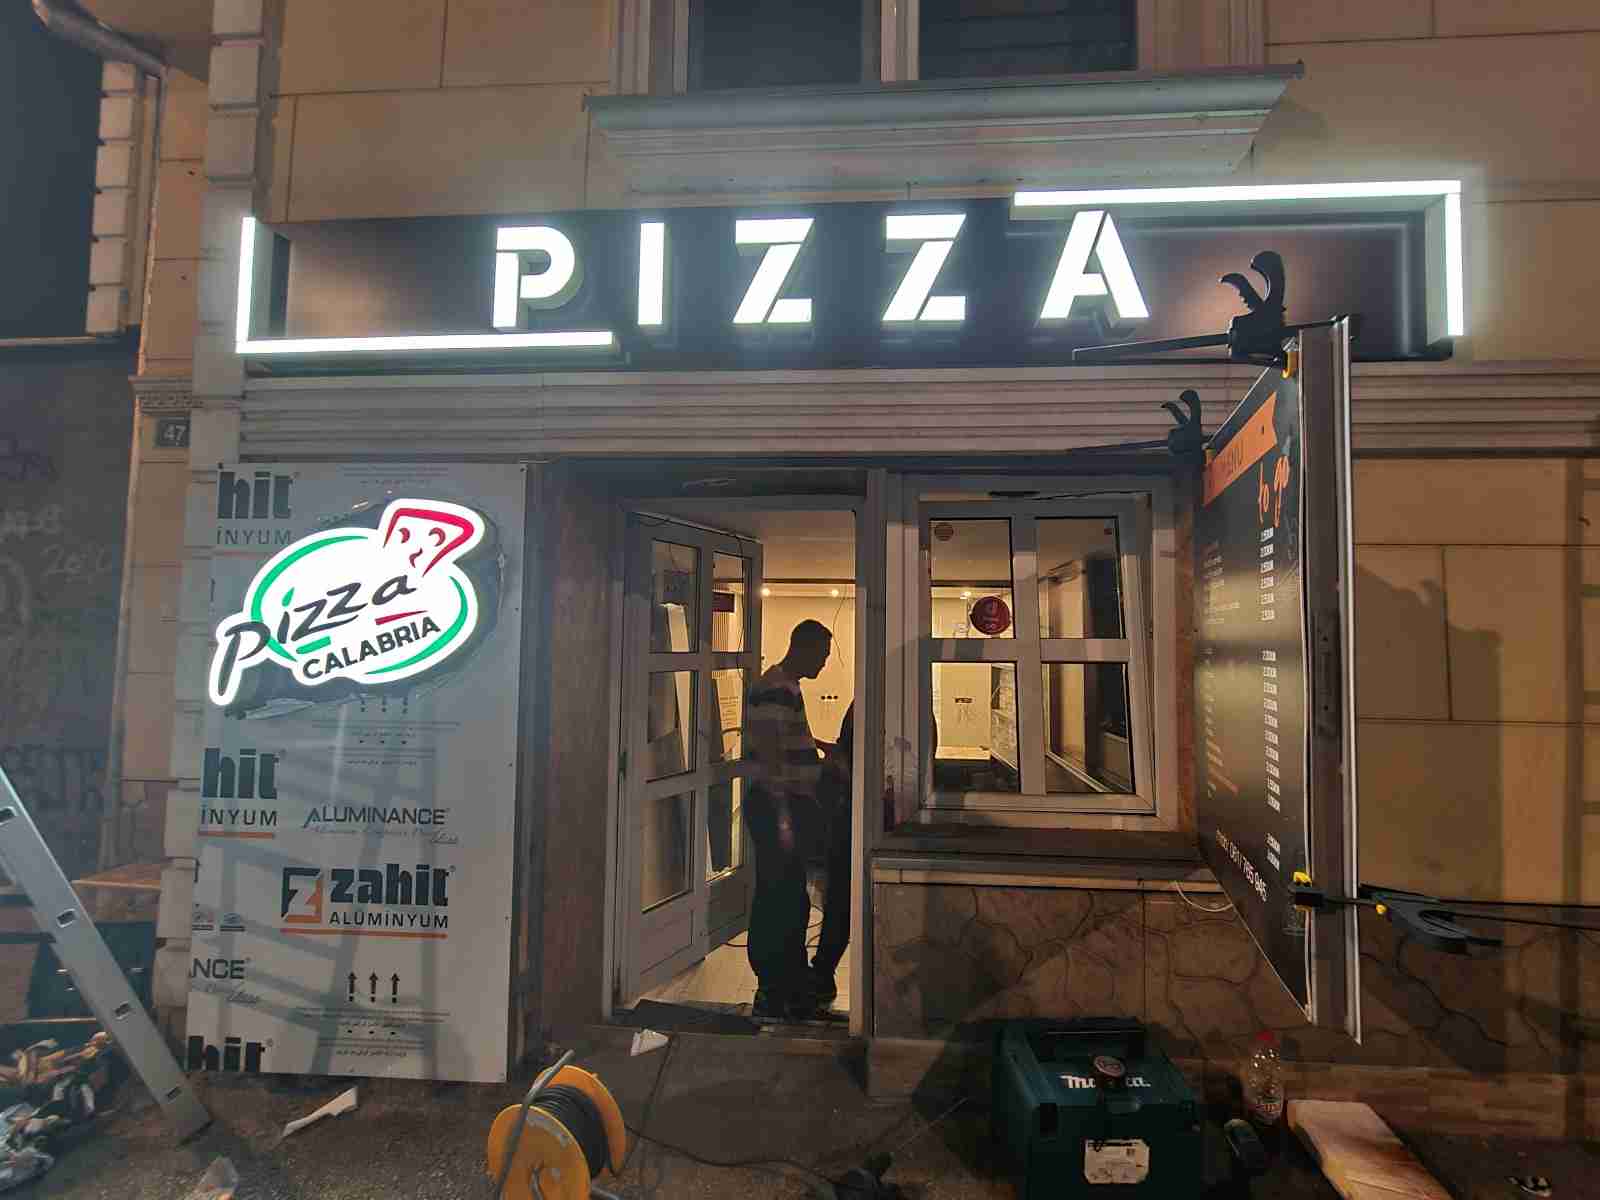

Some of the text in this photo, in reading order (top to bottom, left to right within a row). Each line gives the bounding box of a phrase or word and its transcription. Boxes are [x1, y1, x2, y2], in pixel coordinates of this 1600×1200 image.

[493, 211, 1149, 327] PIZZA
[164, 425, 187, 441] 47
[303, 616, 441, 679] CALABRIA
[303, 806, 448, 829] ALUMINANCE
[330, 863, 449, 906] zahit
[1058, 1074, 1151, 1089] maa
